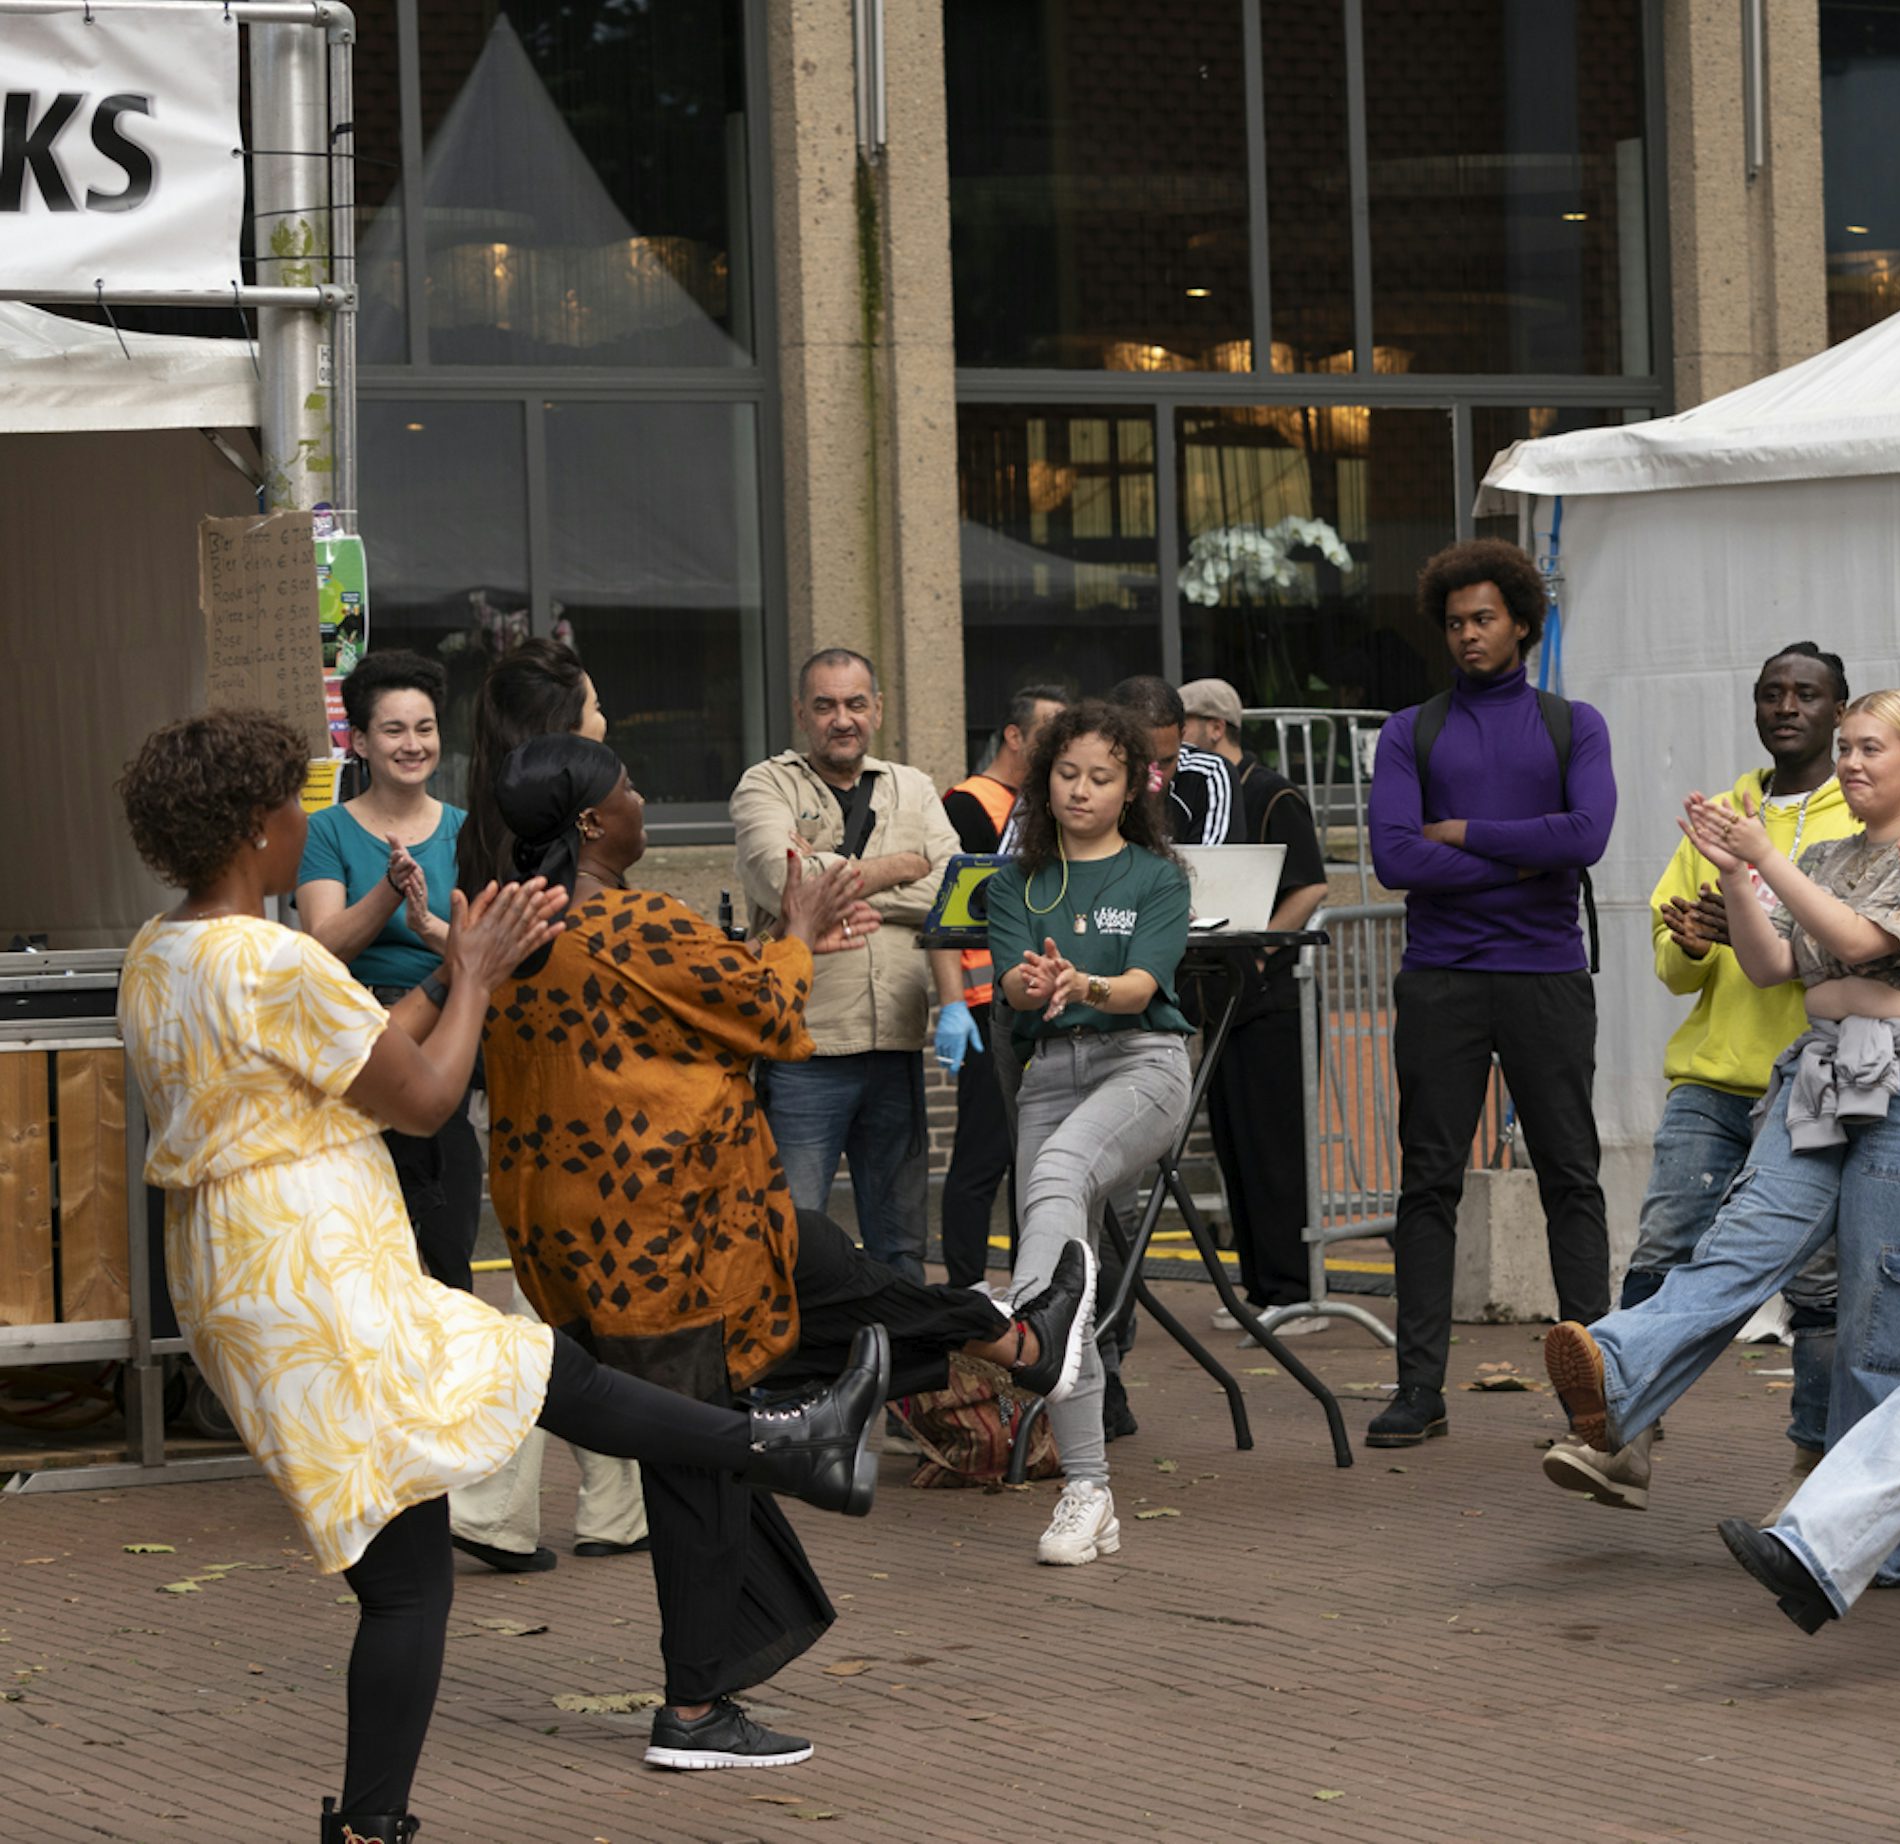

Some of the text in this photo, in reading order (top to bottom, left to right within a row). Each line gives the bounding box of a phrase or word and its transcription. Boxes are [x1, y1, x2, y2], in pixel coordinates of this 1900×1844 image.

[0, 92, 155, 212] KS
[208, 530, 234, 555] Bier
[211, 556, 237, 580] Bier
